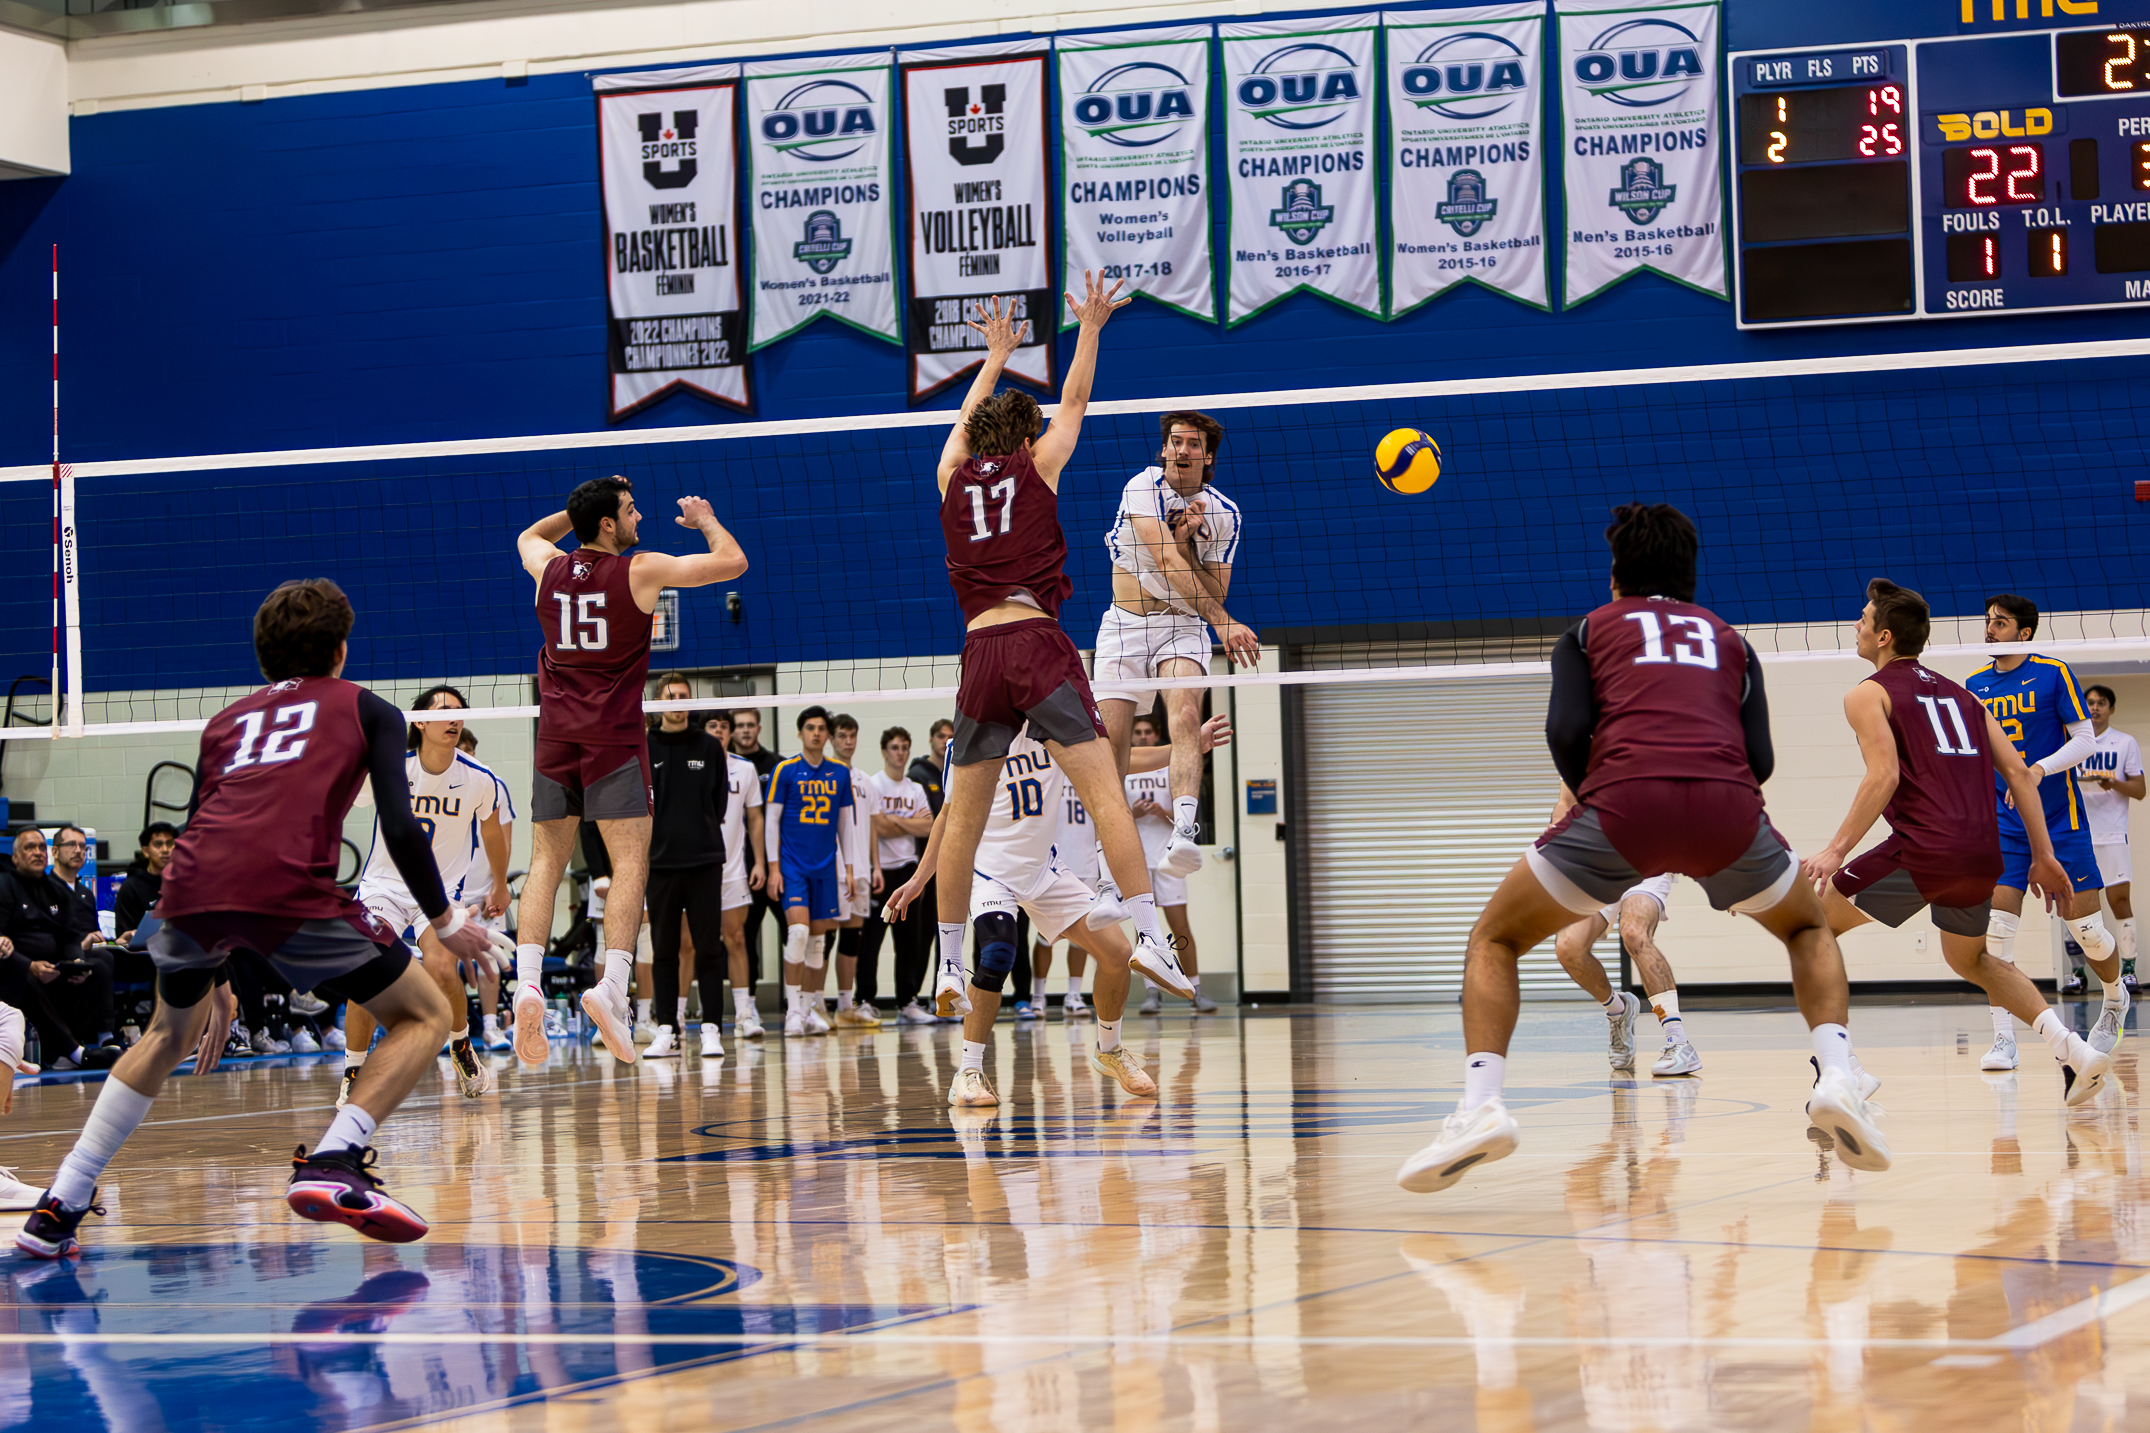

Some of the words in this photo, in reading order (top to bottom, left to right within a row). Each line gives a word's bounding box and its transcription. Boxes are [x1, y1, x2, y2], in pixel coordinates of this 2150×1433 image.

[1401, 59, 1527, 96] OUA
[1574, 46, 1704, 84] OUA
[1756, 61, 1793, 82] PLYR
[1807, 58, 1833, 78] FLS
[1852, 55, 1879, 75] PTS
[1237, 70, 1361, 107] OUA
[1074, 88, 1195, 125] OUA
[1777, 96, 1787, 123] 1
[1869, 85, 1901, 116] 19
[762, 105, 876, 141] OUA
[948, 116, 1004, 135] SPORTS
[642, 142, 697, 160] SPORTS
[1400, 140, 1530, 168] CHAMPIONS
[1574, 127, 1707, 156] CHAMPIONS
[1767, 131, 1787, 163] 2
[1859, 123, 1902, 157] 25
[1238, 150, 1364, 178] CHAMPIONS
[1968, 145, 2039, 205] 22
[761, 183, 880, 209] CHAMPIONS
[953, 179, 1002, 204] WOMEN'S
[1071, 174, 1200, 203] CHAMPIONS
[1615, 190, 1650, 202] WILSON
[1651, 188, 1671, 200] CUP
[649, 202, 697, 225] WOMEN'S
[1099, 211, 1169, 225] Women's
[1942, 210, 2000, 233] FOULS
[2022, 207, 2071, 228] T.O.L.
[920, 203, 1036, 254] VOLLEYBALL
[1097, 226, 1173, 244] Volleyball
[1573, 230, 1618, 243] Men's
[1625, 222, 1715, 242] Basketball
[614, 224, 729, 274] BASKETBALL
[1236, 250, 1279, 262] Men's
[1285, 243, 1371, 261] Basketball
[1397, 242, 1458, 254] Women's
[1463, 235, 1540, 252] Basketball
[1613, 244, 1673, 258] 2015-16
[1984, 237, 1994, 275] 1
[2052, 233, 2061, 271] 1
[1103, 261, 1173, 279] 2017-18
[1275, 264, 1332, 278] 2016-17
[1438, 256, 1497, 270] 2015-16
[760, 277, 816, 291] Women's
[820, 272, 890, 287] Basketball
[798, 291, 850, 306] 2021-22
[1946, 288, 2004, 309] SCORE
[629, 320, 660, 345] 2022
[661, 316, 722, 343] CHAMPIONS
[963, 475, 1016, 543] 17
[64, 539, 74, 584] Senoh
[552, 591, 609, 651] 15
[1622, 610, 1718, 671] 13
[223, 699, 319, 775] 12
[1915, 694, 1980, 756] 11
[797, 780, 837, 795] TMU
[1128, 777, 1167, 789] TMU
[799, 796, 831, 825] 22
[1006, 777, 1044, 821] 10
[1066, 799, 1086, 825] 18
